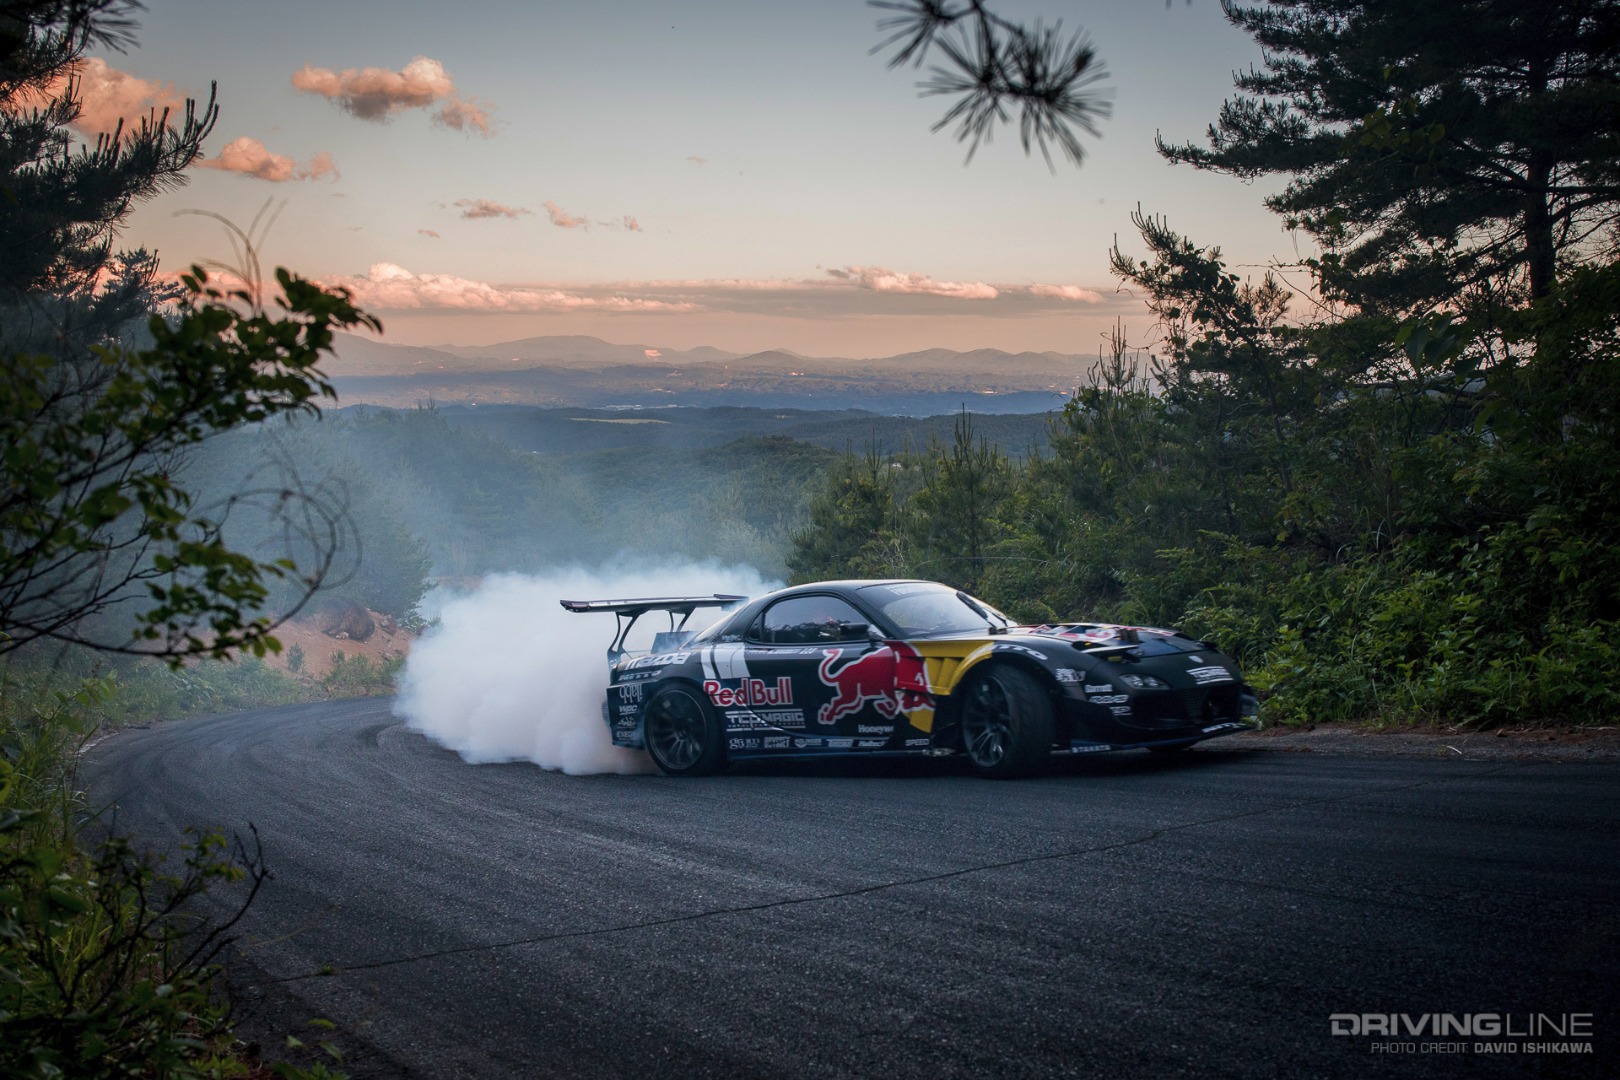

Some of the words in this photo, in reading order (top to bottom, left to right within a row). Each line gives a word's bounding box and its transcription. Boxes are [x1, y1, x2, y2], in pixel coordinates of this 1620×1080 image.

[704, 678, 750, 707] Red
[750, 677, 793, 705] Bull
[905, 738, 930, 746] SPEED
